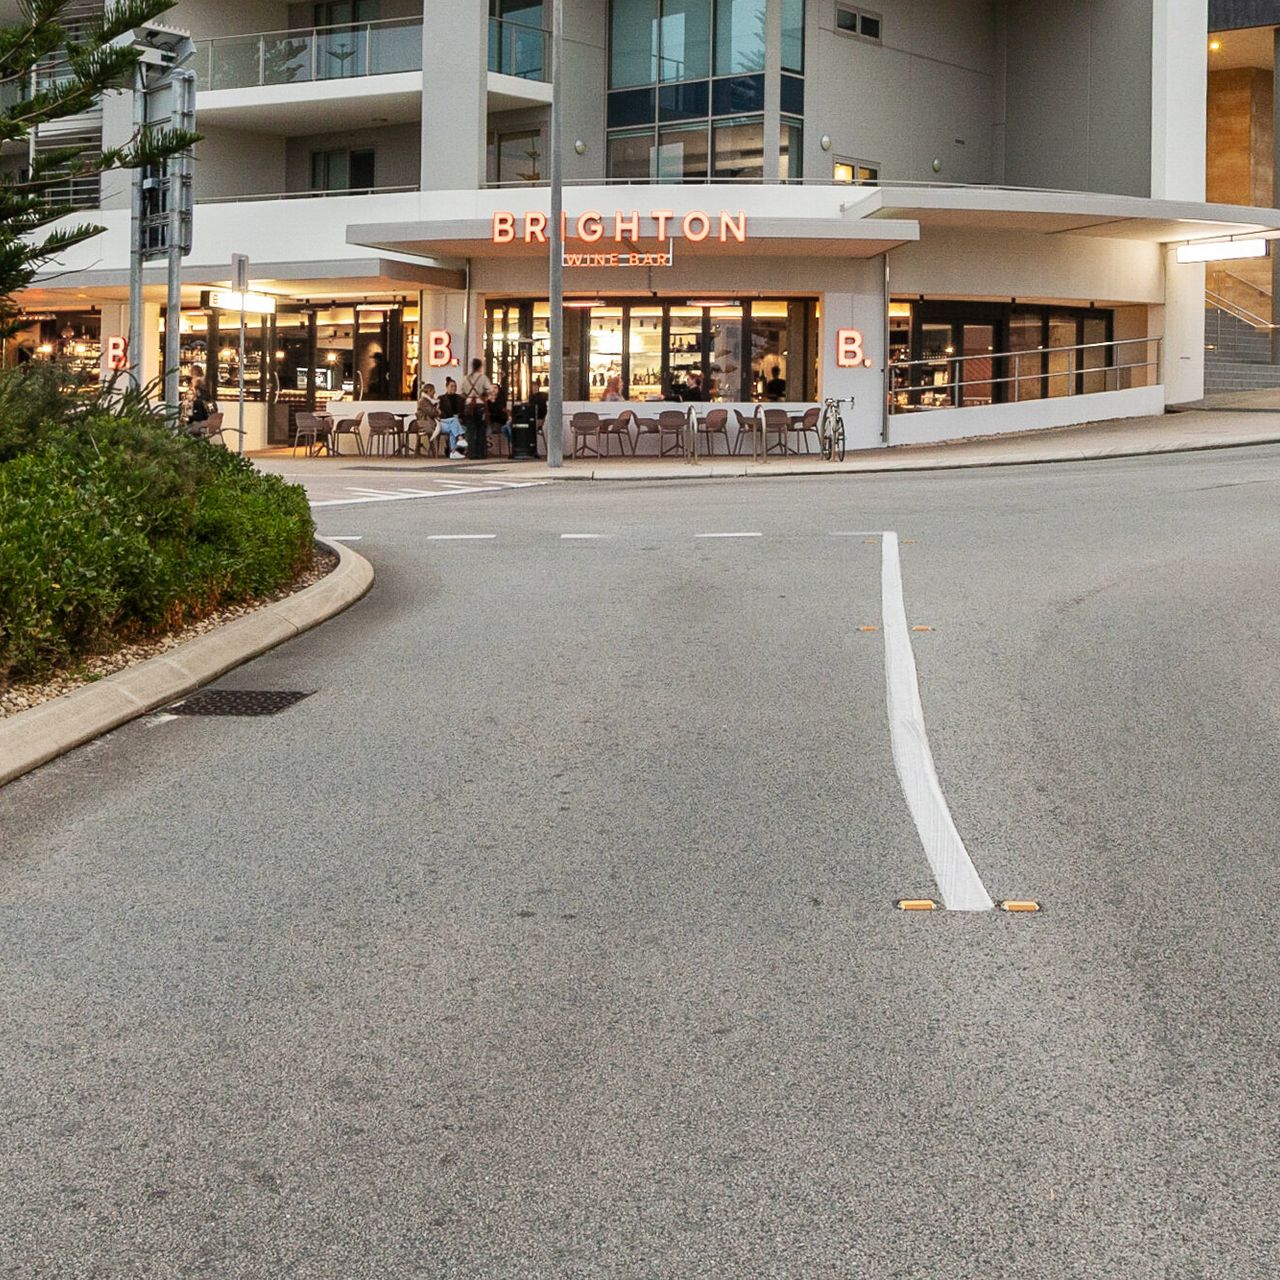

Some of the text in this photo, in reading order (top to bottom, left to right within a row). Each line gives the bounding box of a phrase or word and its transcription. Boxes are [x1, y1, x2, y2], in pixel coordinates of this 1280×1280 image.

[492, 210, 746, 243] BRIGHTON
[565, 253, 668, 266] WINE BAR
